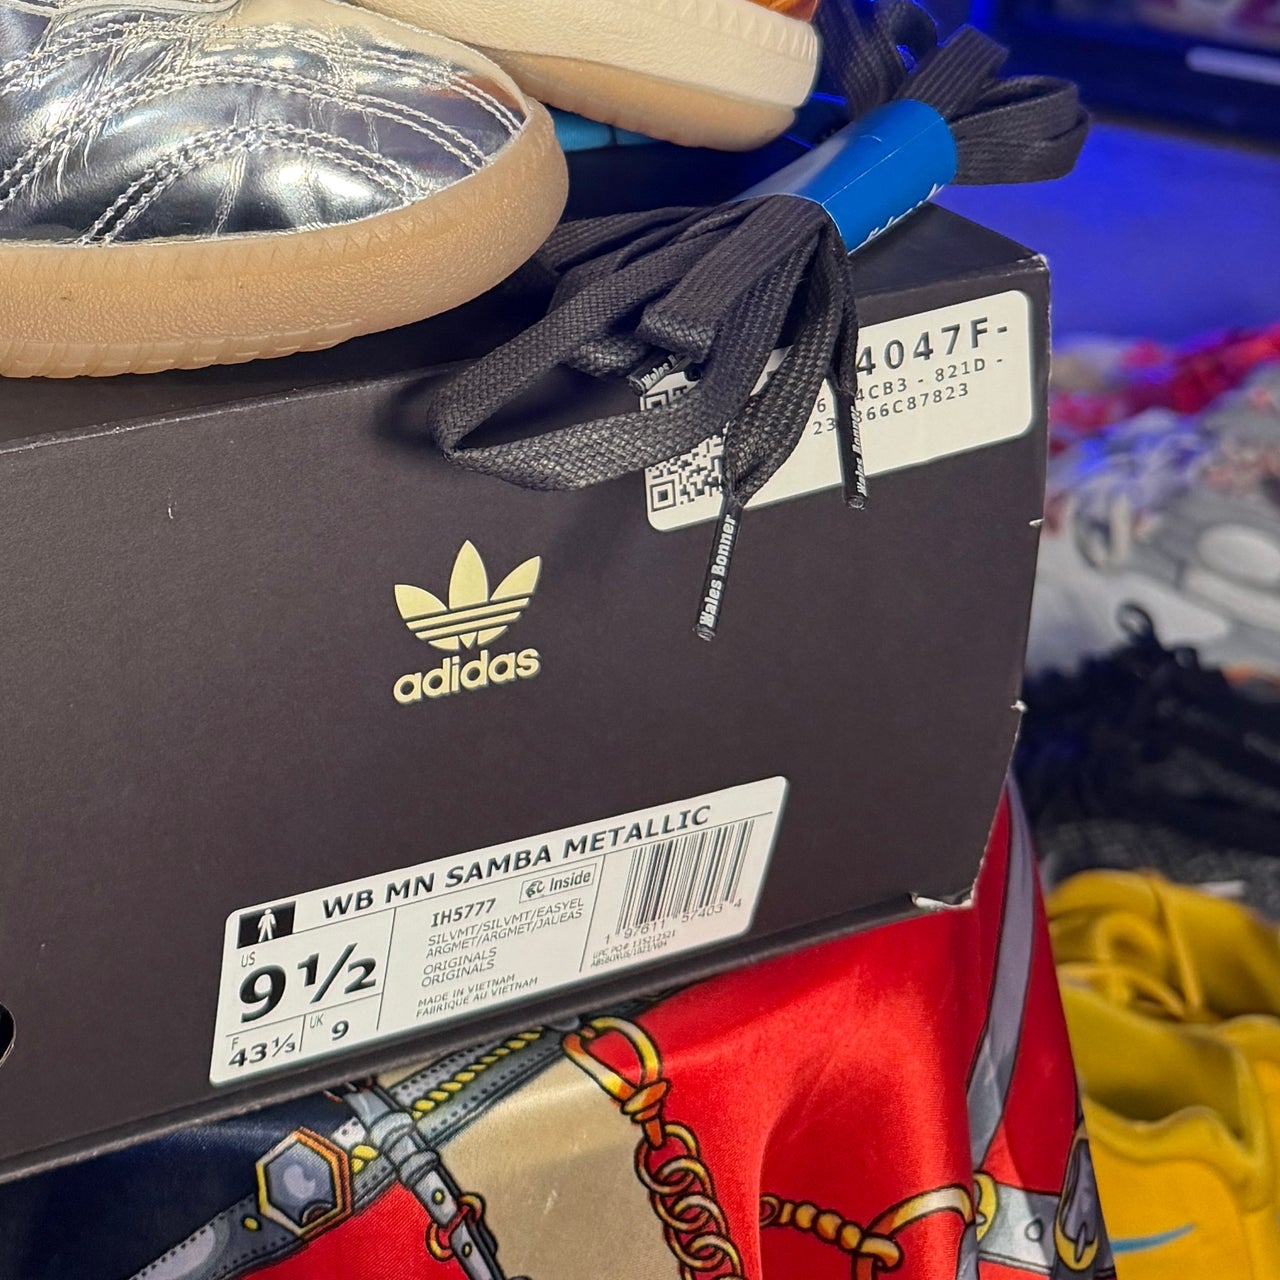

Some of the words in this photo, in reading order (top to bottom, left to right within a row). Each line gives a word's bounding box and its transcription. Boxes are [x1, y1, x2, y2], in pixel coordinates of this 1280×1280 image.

[935, 358, 986, 382] 821D
[699, 579, 723, 628] Wales
[711, 514, 736, 577] Bonner
[393, 648, 542, 705] adidas
[322, 888, 373, 919] WB
[385, 872, 435, 904] MN
[444, 845, 551, 888] SAMBA
[562, 805, 711, 859] METALLIC
[549, 869, 591, 892] Inside
[431, 898, 496, 927] IH5777
[241, 951, 256, 968] US
[421, 959, 495, 987] ORIGINALS
[423, 947, 497, 975] ORIGINALS
[239, 964, 287, 1023] 9
[416, 997, 470, 1018] FABRIQUE
[473, 991, 488, 1003] AU
[491, 977, 539, 997] VIETNAM
[417, 993, 449, 1008] MADE
[452, 988, 464, 999] IN
[468, 974, 516, 994] VIETNAM
[309, 1013, 324, 1029] UK
[331, 1020, 349, 1041] 9
